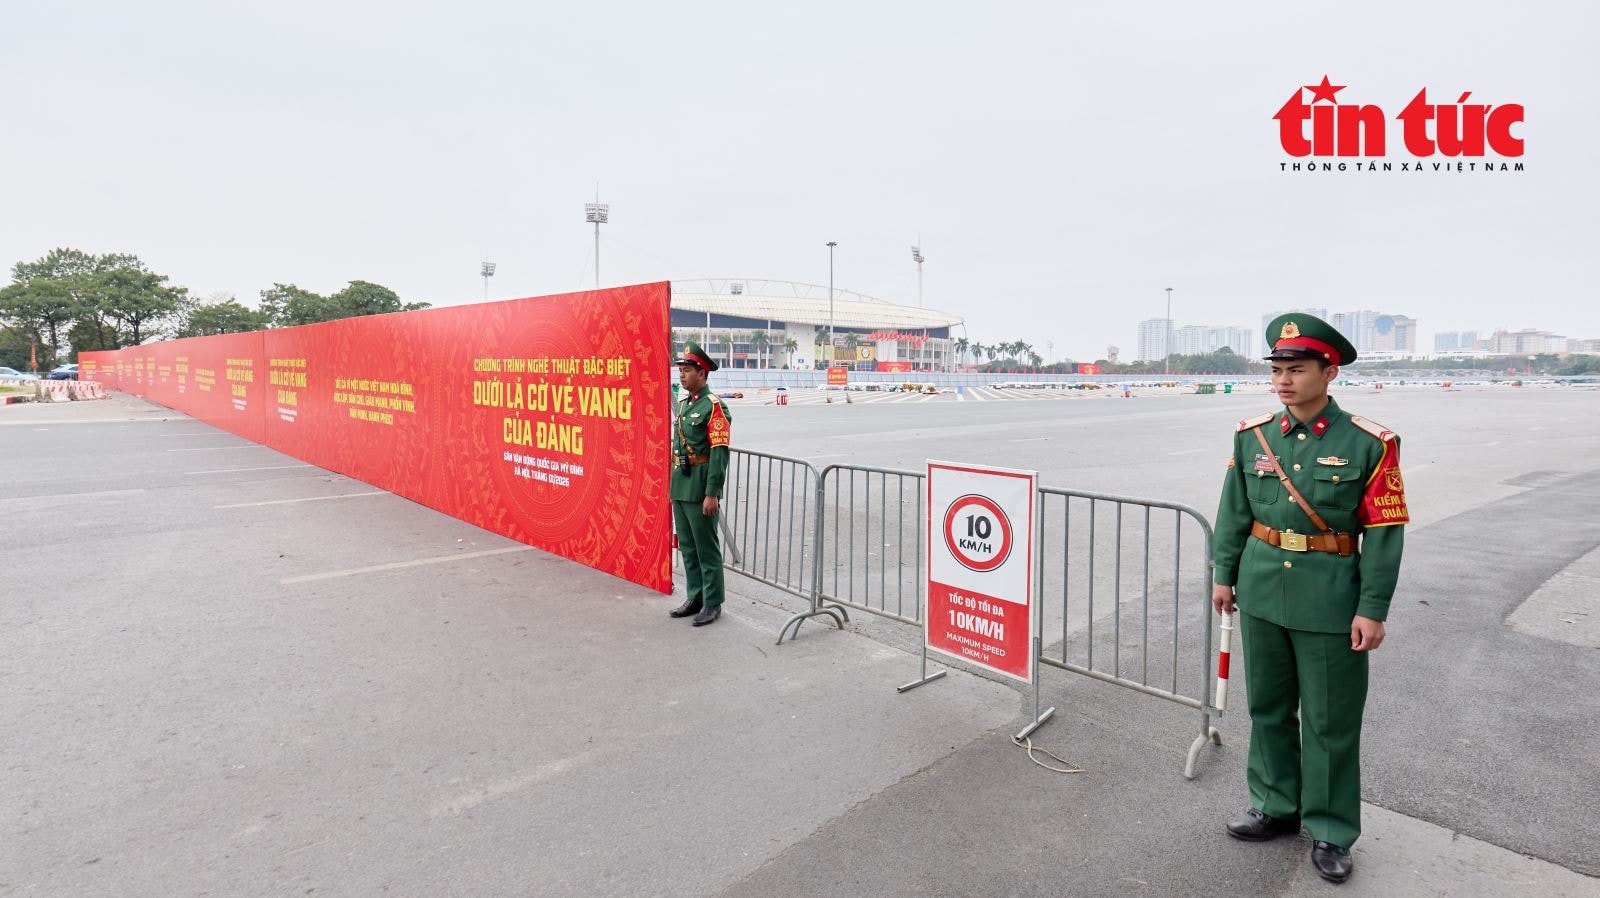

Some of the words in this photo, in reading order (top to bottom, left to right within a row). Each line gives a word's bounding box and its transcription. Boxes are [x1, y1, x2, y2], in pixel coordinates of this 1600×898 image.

[503, 356, 525, 373] TRÌNH
[527, 355, 550, 376] NGHỆ
[551, 355, 580, 378] THUẬT
[583, 356, 603, 378] ĐẶC
[607, 356, 631, 379] BIỆT
[474, 376, 503, 407] DƯỚI
[527, 378, 549, 412] CỜ
[551, 377, 574, 414] VẺ
[577, 386, 632, 420] VANG
[503, 411, 533, 447] CỦA
[536, 415, 583, 455] ĐẢNG
[1374, 492, 1401, 507] KIỂM
[966, 514, 992, 539] 10
[959, 538, 992, 553] KM/H
[948, 593, 963, 606] TỐC
[965, 596, 976, 610] ĐỘ
[977, 598, 991, 613] TỐI
[992, 606, 1004, 617] ĐA
[949, 609, 1004, 641] 10KM/H
[947, 632, 981, 650] MAXIMUM
[982, 642, 1006, 657] SPEED
[961, 647, 989, 662] 10KM/H
